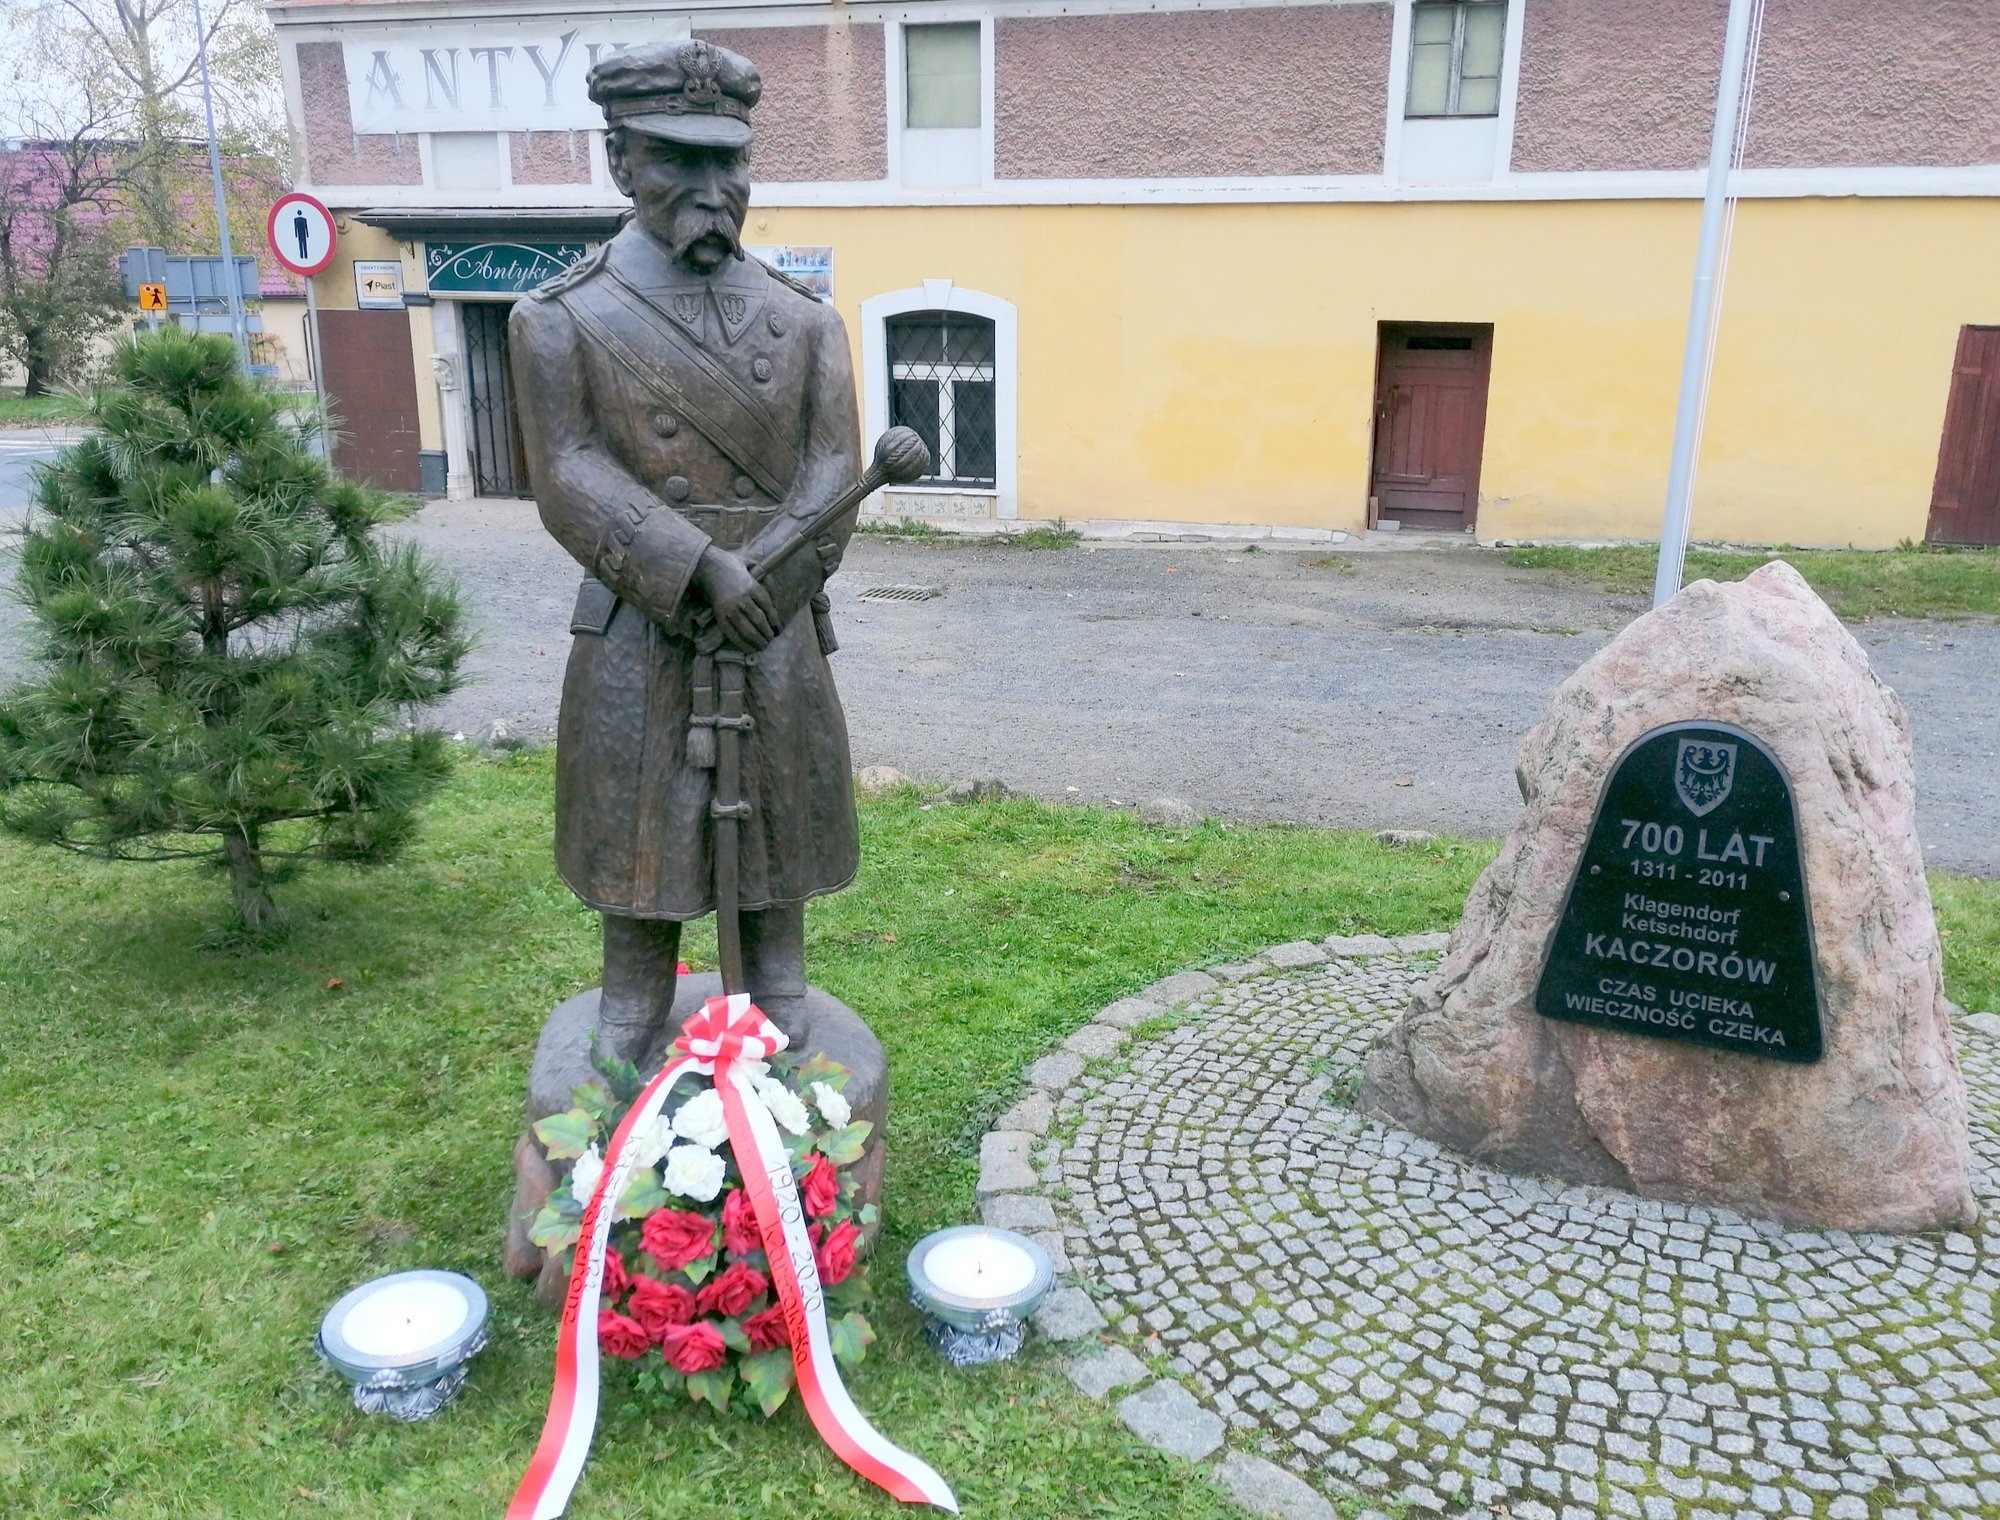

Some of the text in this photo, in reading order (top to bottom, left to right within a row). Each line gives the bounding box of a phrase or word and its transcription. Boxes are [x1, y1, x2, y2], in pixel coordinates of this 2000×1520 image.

[375, 281, 396, 290] Piast
[453, 250, 550, 291] Antyki
[1621, 819, 1774, 867] 700 LAT
[1630, 859, 1677, 881] 1311
[1699, 868, 1748, 891] 2011
[1622, 914, 1739, 945] Ketschdorf
[1624, 892, 1741, 926] Klagendorf
[1585, 932, 1777, 985] KACZORÓW
[1598, 978, 1755, 1019] CZAS UCIEKA
[1565, 993, 1786, 1047] WIECZNOŚĆ CZEKA
[768, 1160, 801, 1224] 1920
[792, 1251, 822, 1313] 2020
